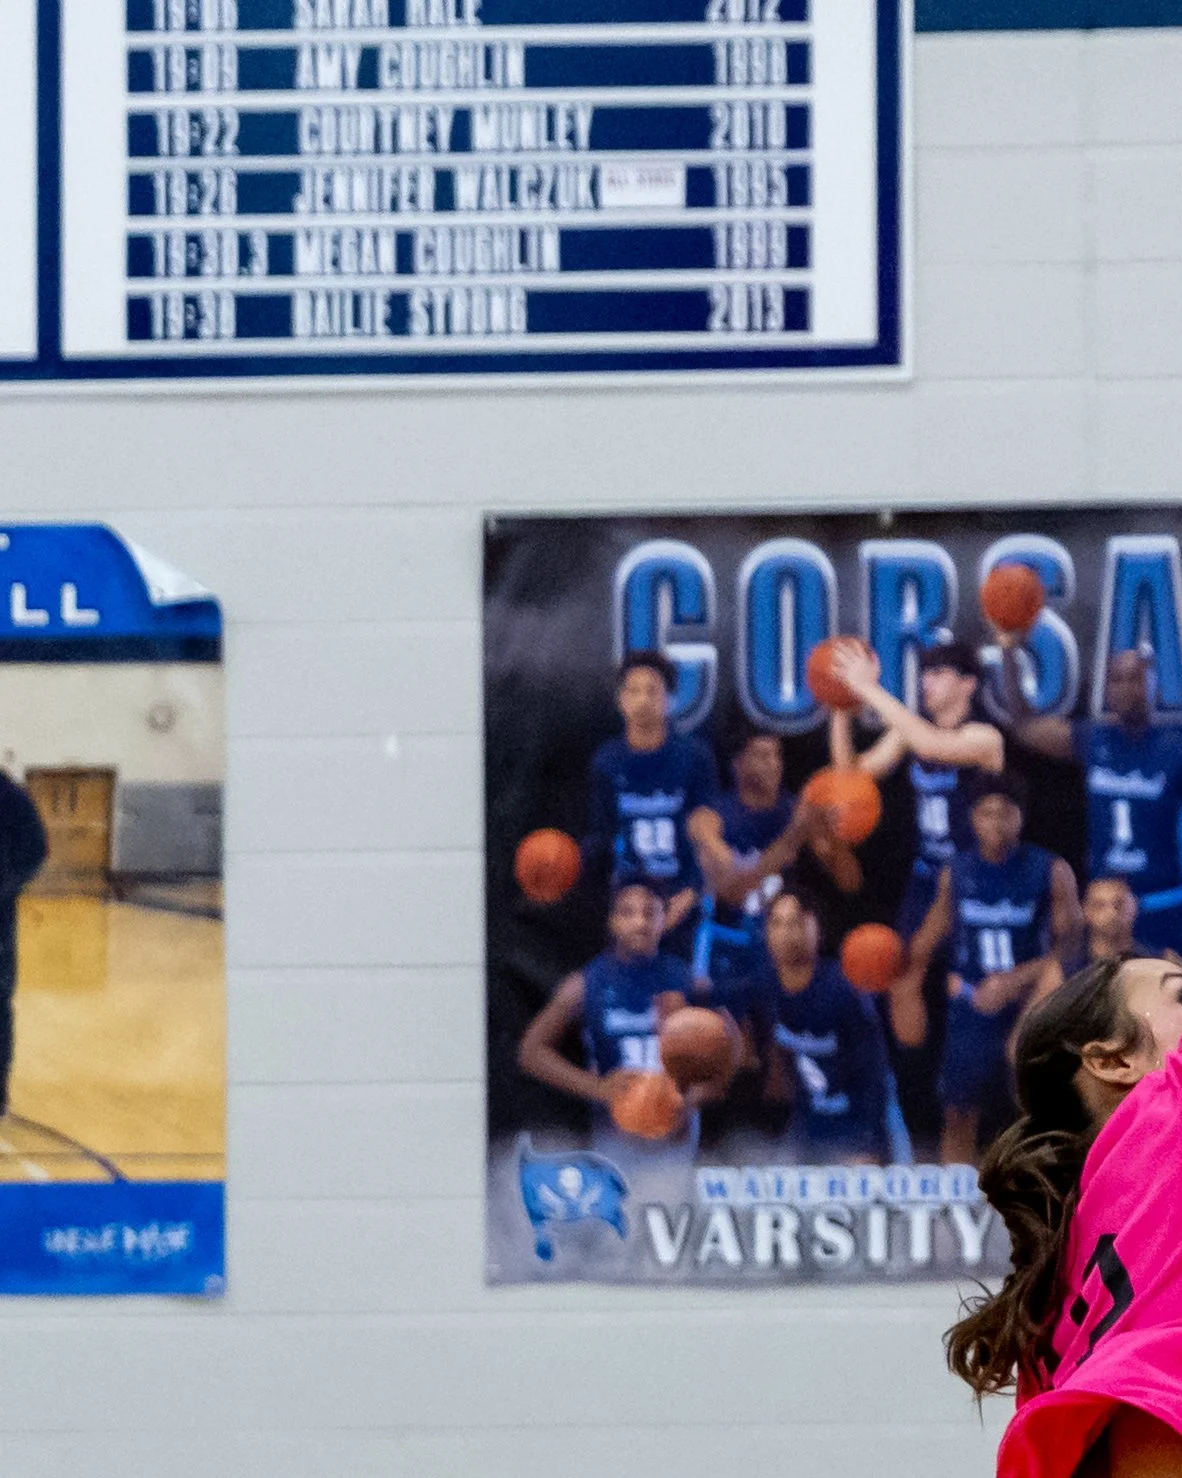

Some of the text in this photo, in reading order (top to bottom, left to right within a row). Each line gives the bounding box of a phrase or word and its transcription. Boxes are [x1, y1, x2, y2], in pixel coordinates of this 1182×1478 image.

[296, 42, 361, 89] AMY
[377, 40, 525, 88] COUGHLIN
[298, 105, 454, 154] COURTNEY
[470, 103, 594, 152] MUNLEY
[293, 165, 434, 212] JENNIFER
[296, 226, 396, 275] MEGAN
[412, 225, 559, 274] COUGHLIN
[408, 287, 527, 335] STRONG
[645, 1203, 997, 1269] VARSITY
